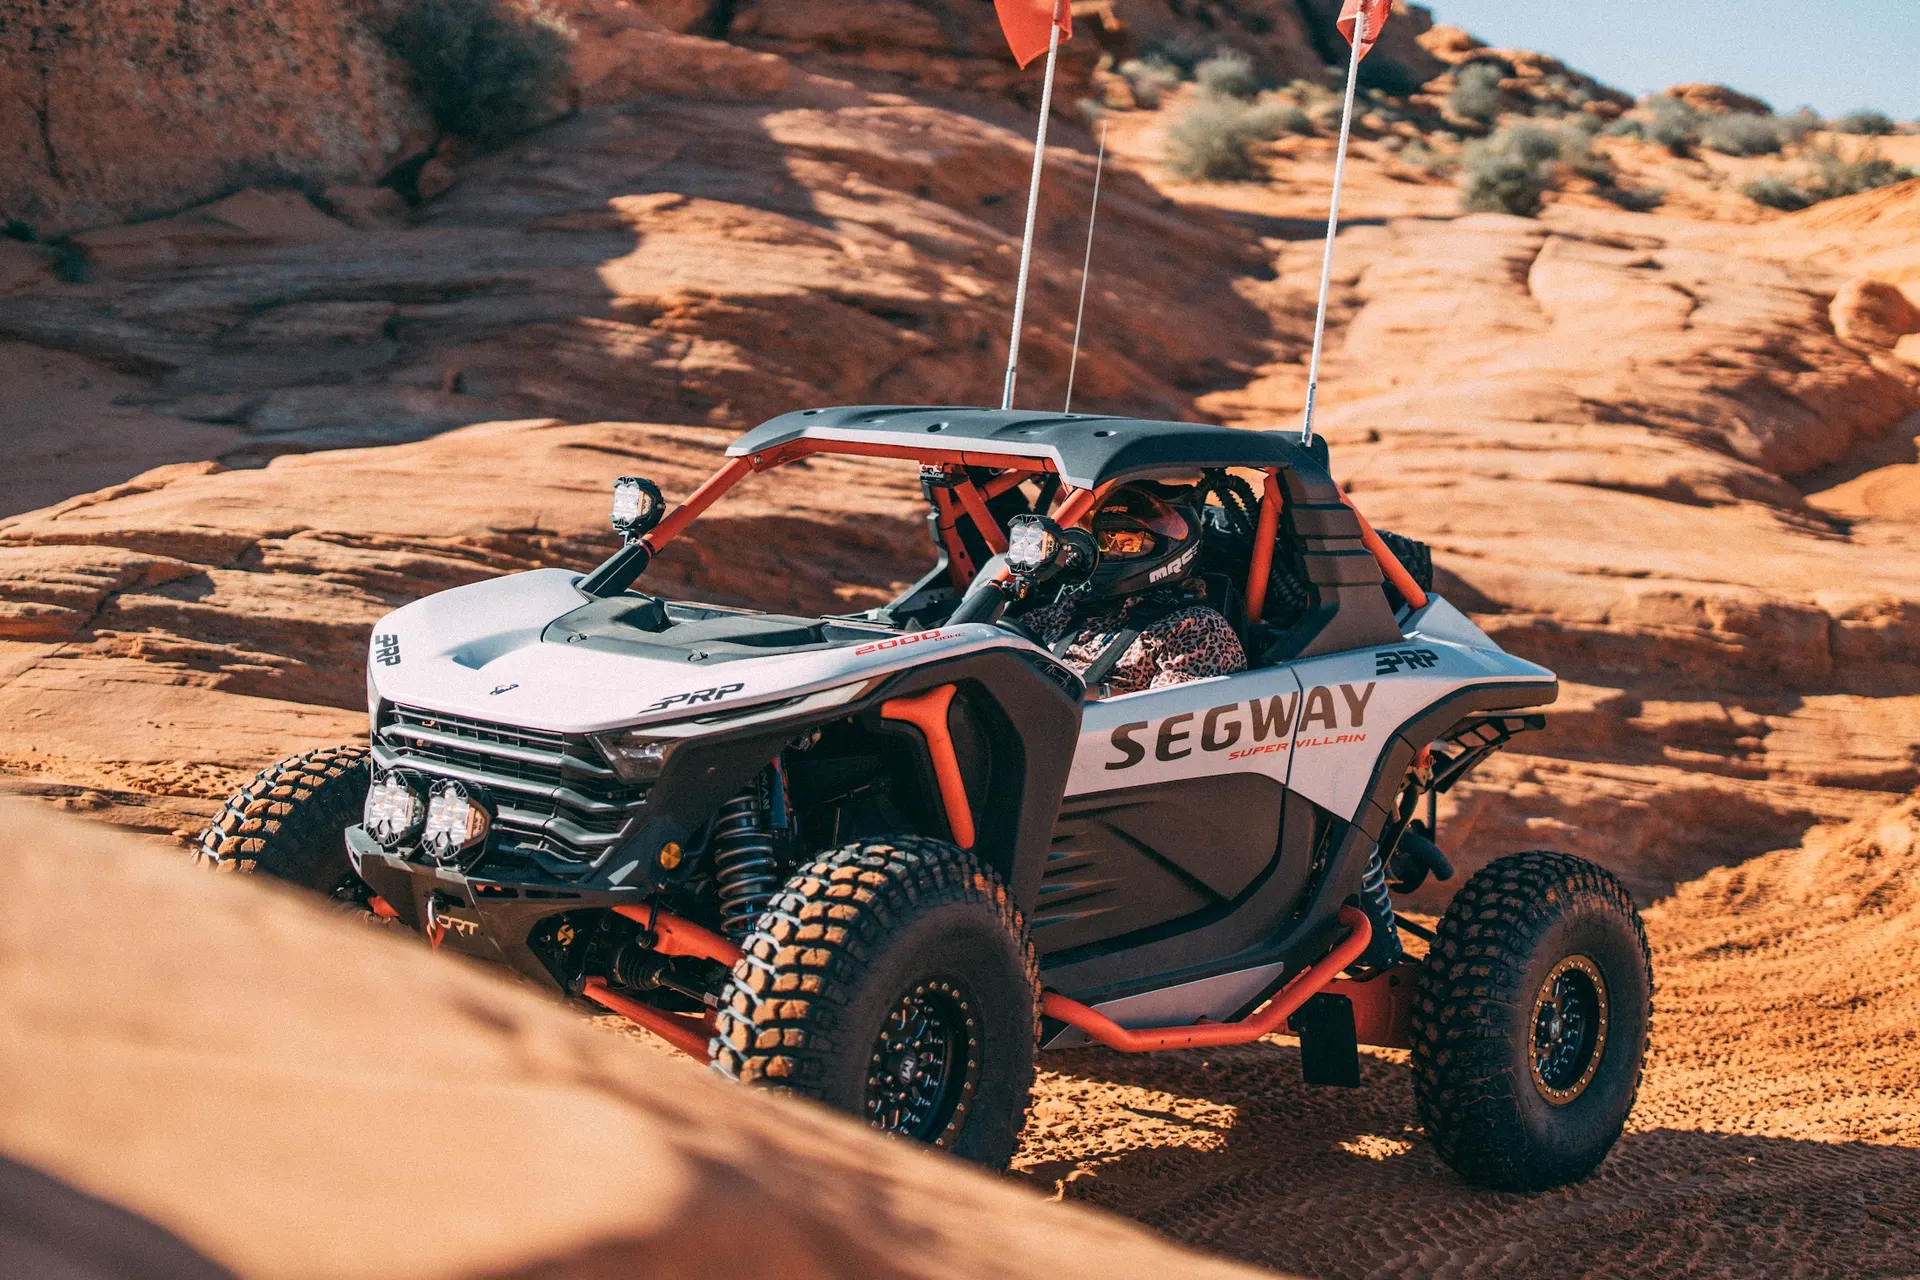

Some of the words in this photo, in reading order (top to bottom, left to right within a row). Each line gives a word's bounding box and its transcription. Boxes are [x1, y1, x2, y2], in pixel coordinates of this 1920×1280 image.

[855, 630, 941, 656] 2000
[1375, 649, 1440, 676] PRP
[638, 682, 745, 714] PRP
[1105, 682, 1376, 770] SEGWAY
[1228, 742, 1289, 761] SUPER
[1295, 733, 1367, 749] VILLAIN
